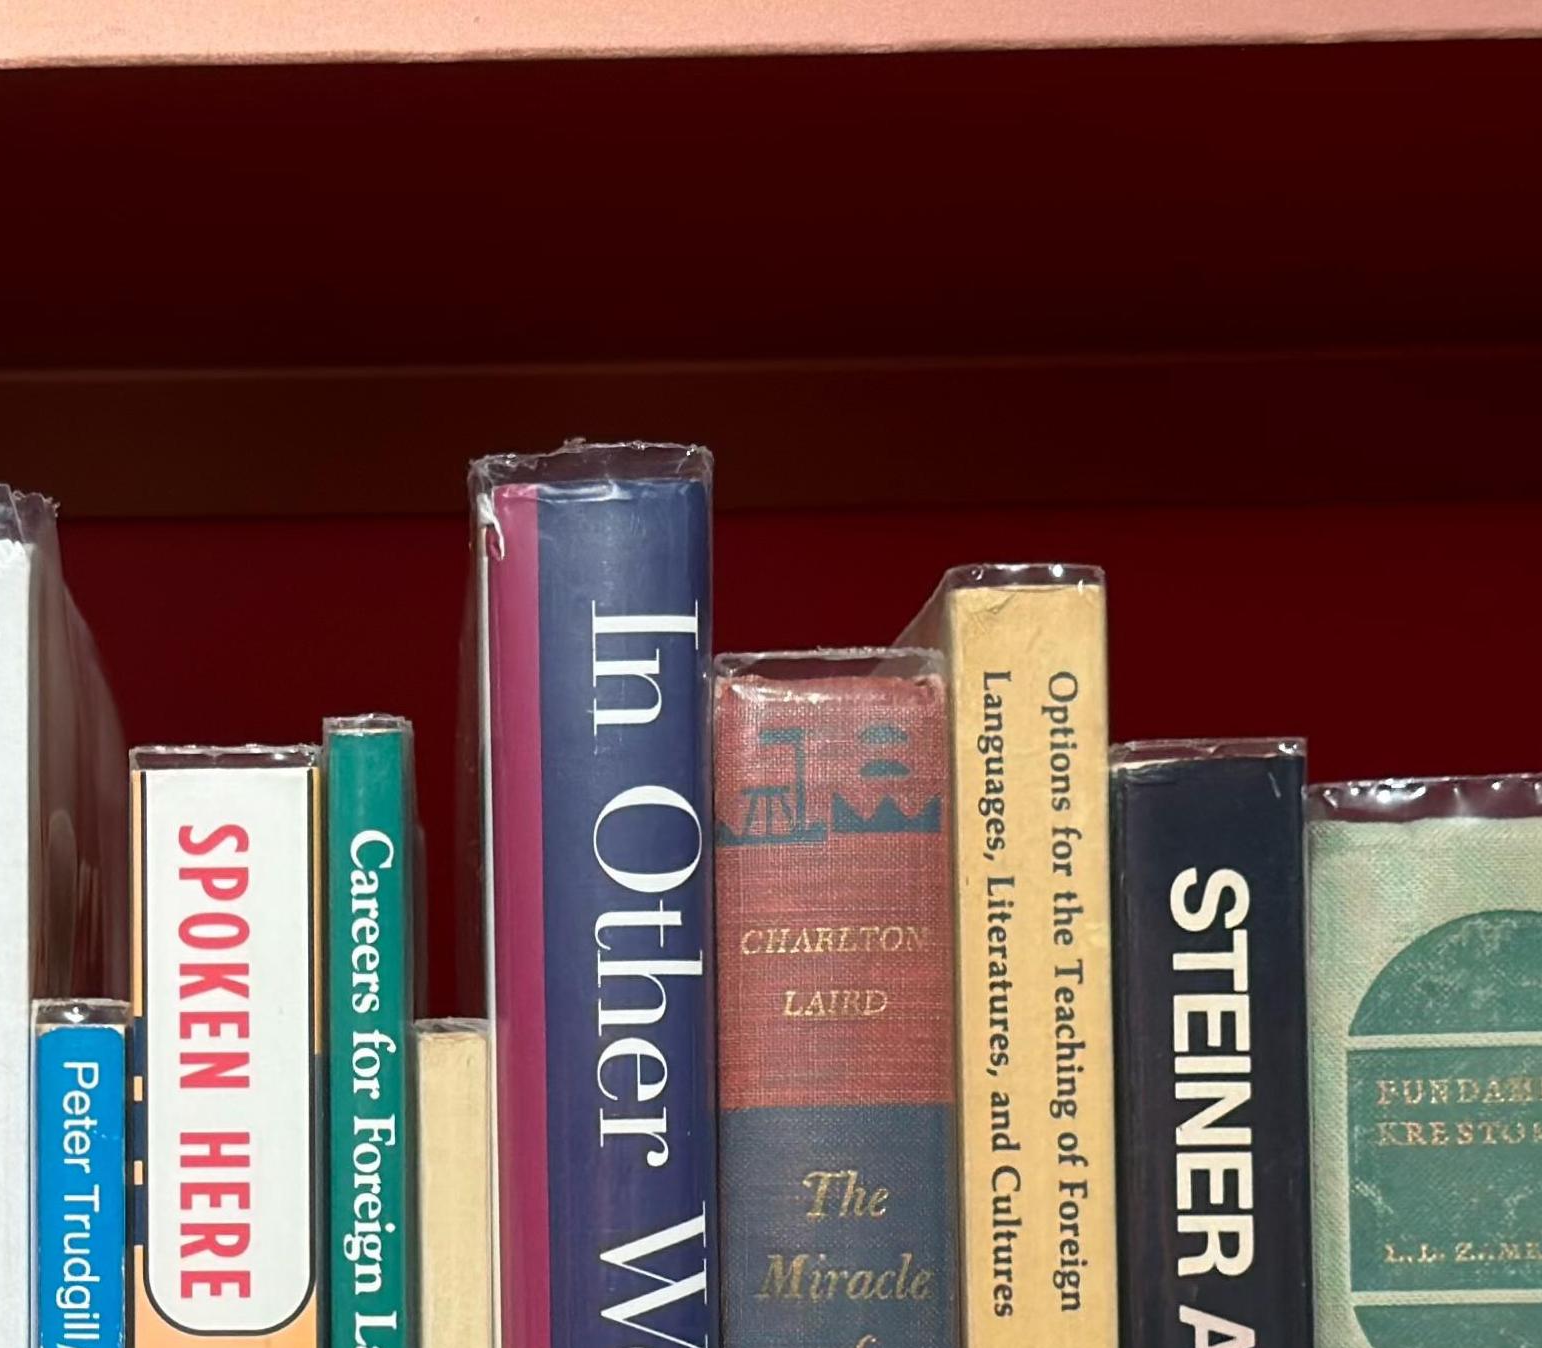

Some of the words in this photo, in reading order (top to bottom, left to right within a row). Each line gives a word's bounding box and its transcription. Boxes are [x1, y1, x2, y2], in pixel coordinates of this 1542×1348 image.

[592, 599, 698, 736] In
[978, 671, 1012, 860] Languages,
[1042, 671, 1078, 812] Options
[1052, 826, 1082, 877] for
[1053, 891, 1084, 945] the
[178, 824, 250, 1089] SPOKEN
[349, 829, 395, 1013] Careers
[593, 785, 703, 1168] Other
[740, 925, 928, 956] CHARLTON
[985, 876, 1015, 1077] Literatures,
[351, 1030, 397, 1099] for
[781, 989, 889, 1017] LAIRD
[1050, 958, 1086, 1118] Teaching
[62, 1062, 99, 1173] Peter
[991, 1091, 1020, 1152] and
[1169, 867, 1255, 1277] STEINER
[179, 1132, 250, 1299] HERE
[342, 1113, 396, 1295] Foreign
[801, 1169, 889, 1219] The
[1058, 1132, 1088, 1167] of
[755, 1253, 934, 1301] Miracle
[992, 1165, 1022, 1317] Cultures
[1053, 1180, 1088, 1312] Foreign
